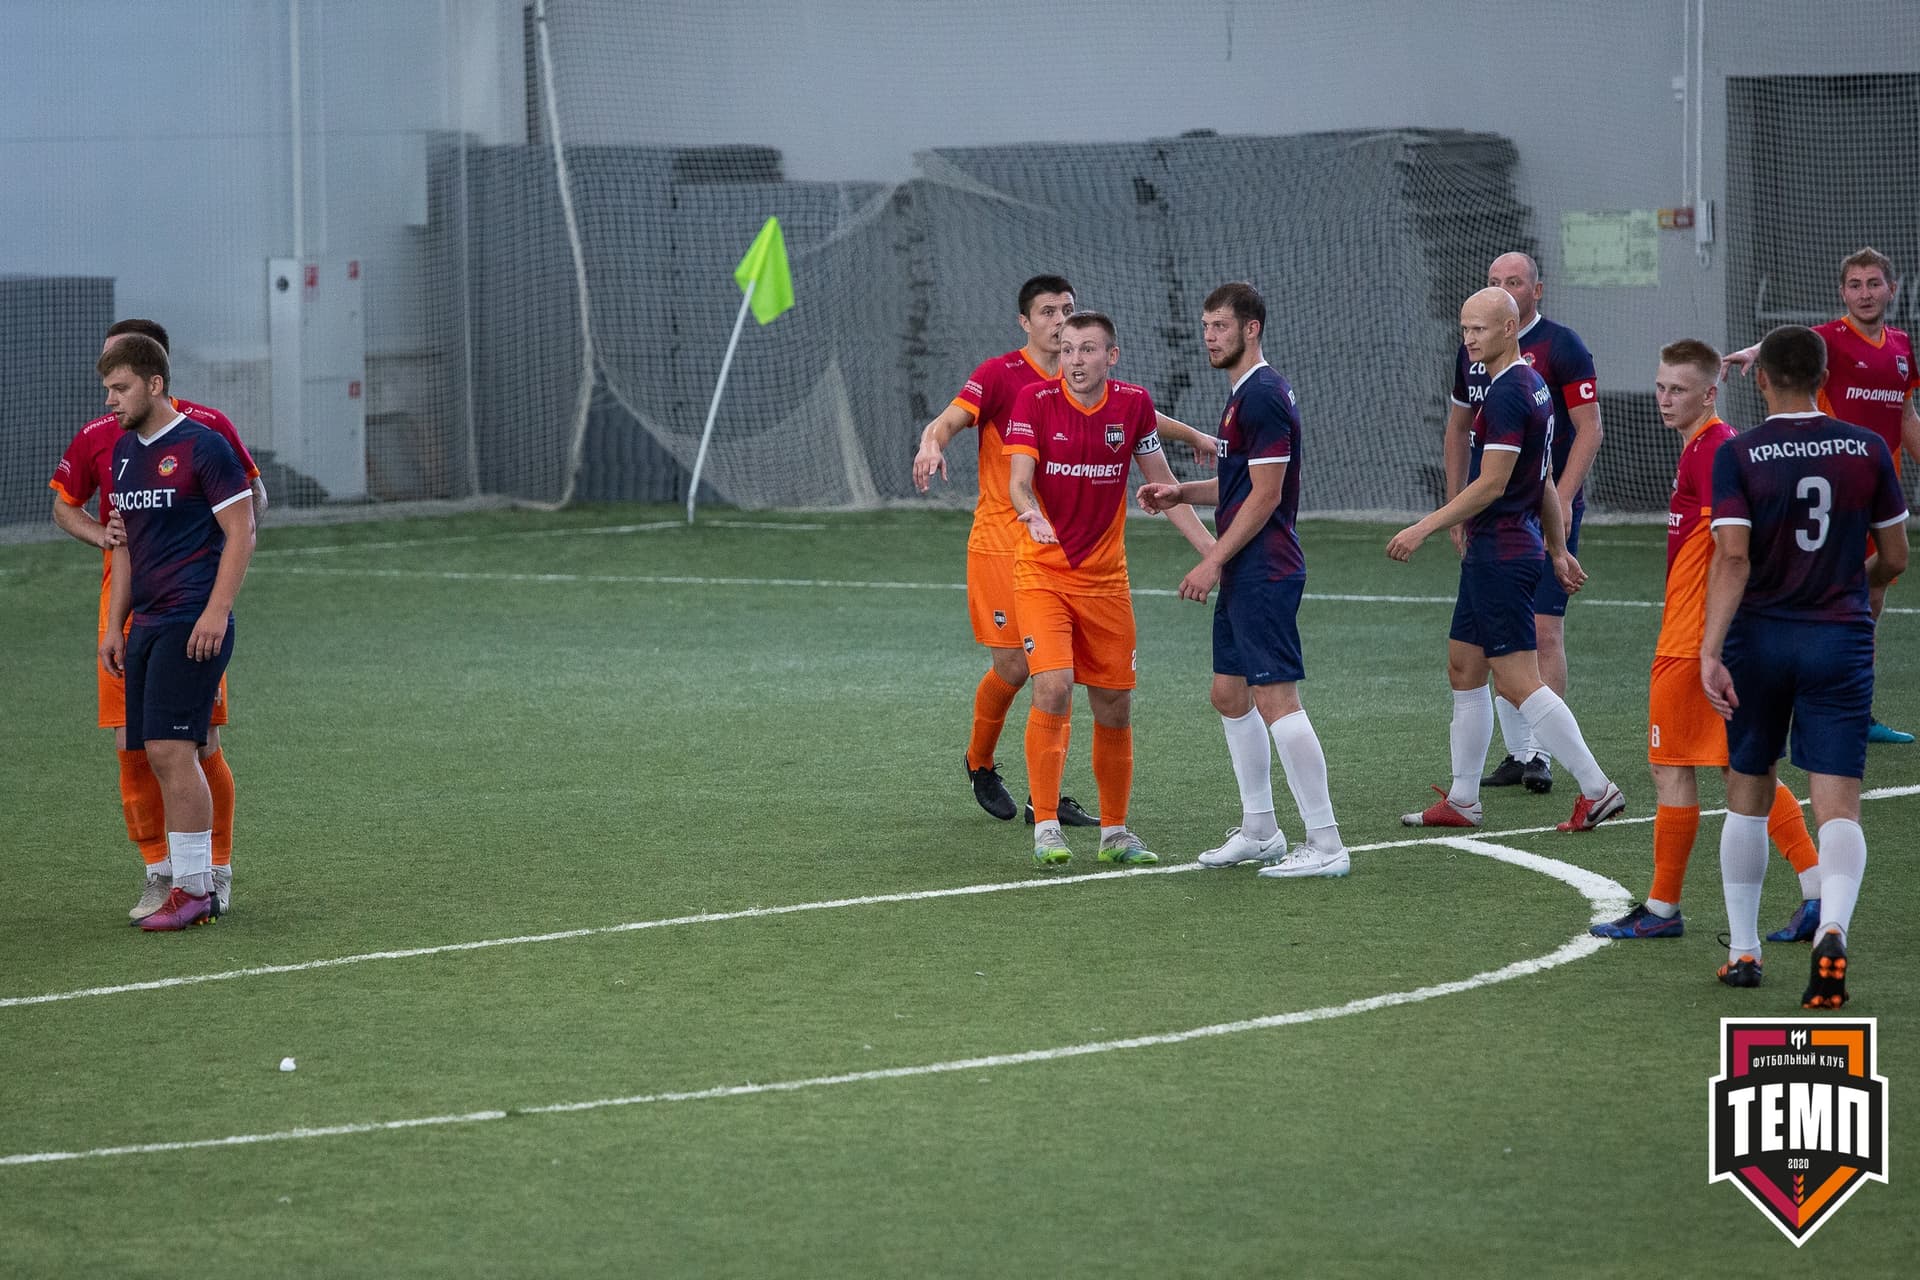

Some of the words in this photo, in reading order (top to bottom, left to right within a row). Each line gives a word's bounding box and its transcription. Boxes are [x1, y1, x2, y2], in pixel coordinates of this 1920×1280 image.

[1579, 382, 1594, 400] C
[1748, 438, 1869, 463] КРАСНОЯРСК
[117, 458, 130, 481] 7
[1045, 461, 1124, 478] ПРОДИНВЕСТ
[1795, 476, 1832, 552] 3
[1652, 725, 1660, 748] 8
